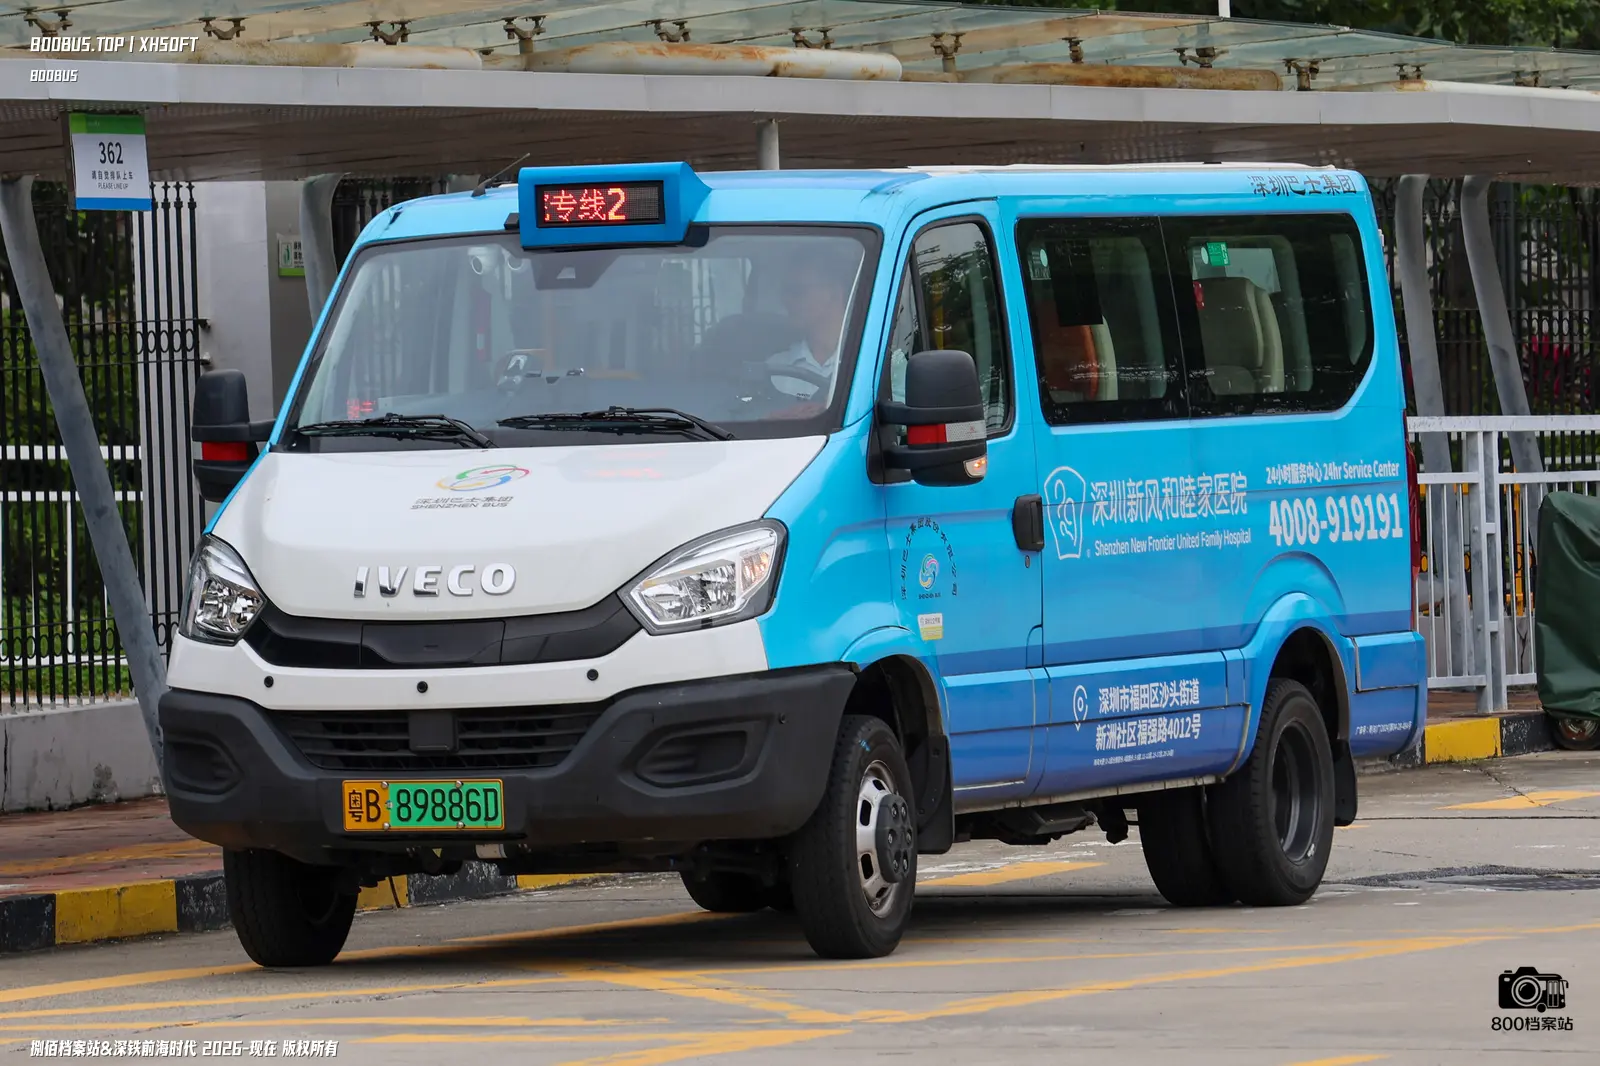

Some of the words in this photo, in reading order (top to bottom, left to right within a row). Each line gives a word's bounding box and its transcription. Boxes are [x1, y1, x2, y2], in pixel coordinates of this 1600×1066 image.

[98, 141, 124, 165] 362
[91, 170, 133, 180] 请自觉排队上车
[98, 182, 113, 190] PLEASE
[114, 182, 122, 190] LINE
[1247, 174, 1357, 197] 深圳巴士集团
[544, 187, 626, 221] 专线2
[1323, 461, 1342, 481] 24hr
[1343, 459, 1372, 480] Service
[1373, 460, 1400, 478] Center
[410, 502, 479, 510] SHENZHEN
[415, 496, 514, 504] 深圳巴士集团
[1090, 470, 1248, 527] 深圳新风和睦家医院
[1269, 492, 1403, 547] 4008-919191
[1094, 537, 1129, 557] Shenzhen
[1130, 537, 1147, 553] New
[1148, 535, 1176, 552] Frontier
[1177, 532, 1200, 549] United
[1201, 530, 1223, 550] Family
[1223, 528, 1252, 548] Hospital
[353, 562, 517, 598] IVECO
[1098, 678, 1200, 714] 深圳市福田区沙头街道
[1095, 713, 1202, 752] 新洲社区福强路4012号
